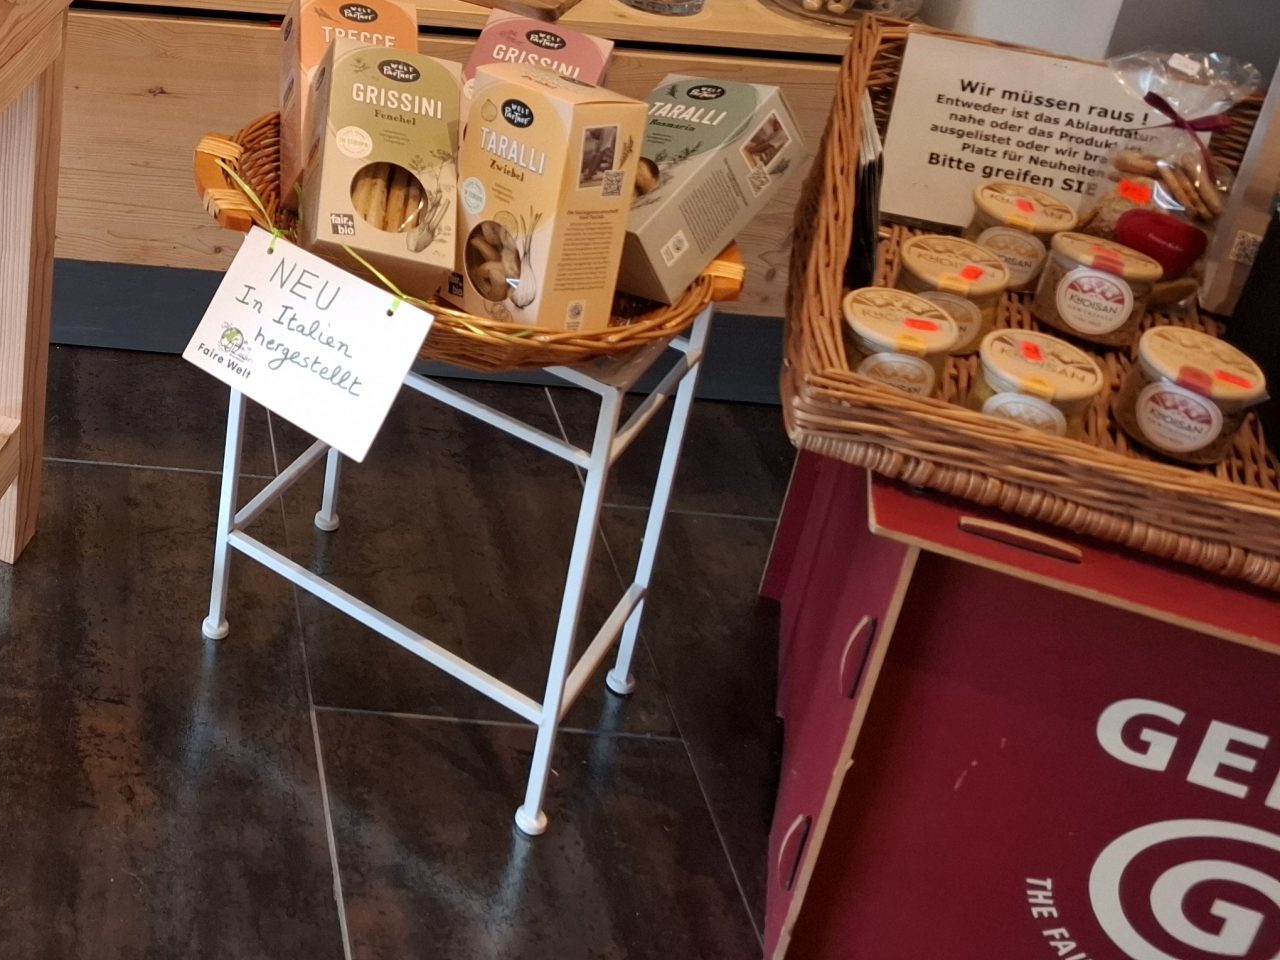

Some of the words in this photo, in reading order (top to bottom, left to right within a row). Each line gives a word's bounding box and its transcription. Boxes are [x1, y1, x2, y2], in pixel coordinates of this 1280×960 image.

[351, 83, 443, 120] GRISSINI
[374, 109, 417, 126] Fenchel
[648, 101, 728, 126] TARALLI
[936, 93, 1008, 115] Entweder
[1011, 107, 1030, 120] ist
[1034, 111, 1061, 125] das
[960, 78, 995, 97] Wir
[1001, 87, 1081, 114] müssen
[1088, 105, 1135, 124] raus
[930, 123, 1014, 148] ausgelistet
[1016, 138, 1050, 154] oder
[1055, 146, 1079, 159] wir
[949, 111, 986, 127] nahe
[990, 119, 1025, 136] oder
[1028, 125, 1055, 140] das
[480, 127, 546, 176] TARALLI
[961, 142, 998, 159] Platz
[1002, 149, 1025, 163] für
[1028, 155, 1106, 178] Neuheiten
[489, 159, 525, 183] Zwiebel
[928, 152, 977, 173] Bitte
[981, 163, 1055, 189] greifen
[235, 284, 264, 314] In
[269, 256, 341, 311] NEU
[272, 305, 352, 359] Italien
[197, 342, 224, 364] Faire
[226, 358, 252, 380] Welt
[254, 326, 363, 397] hergestellt
[1025, 877, 1059, 919] THE
